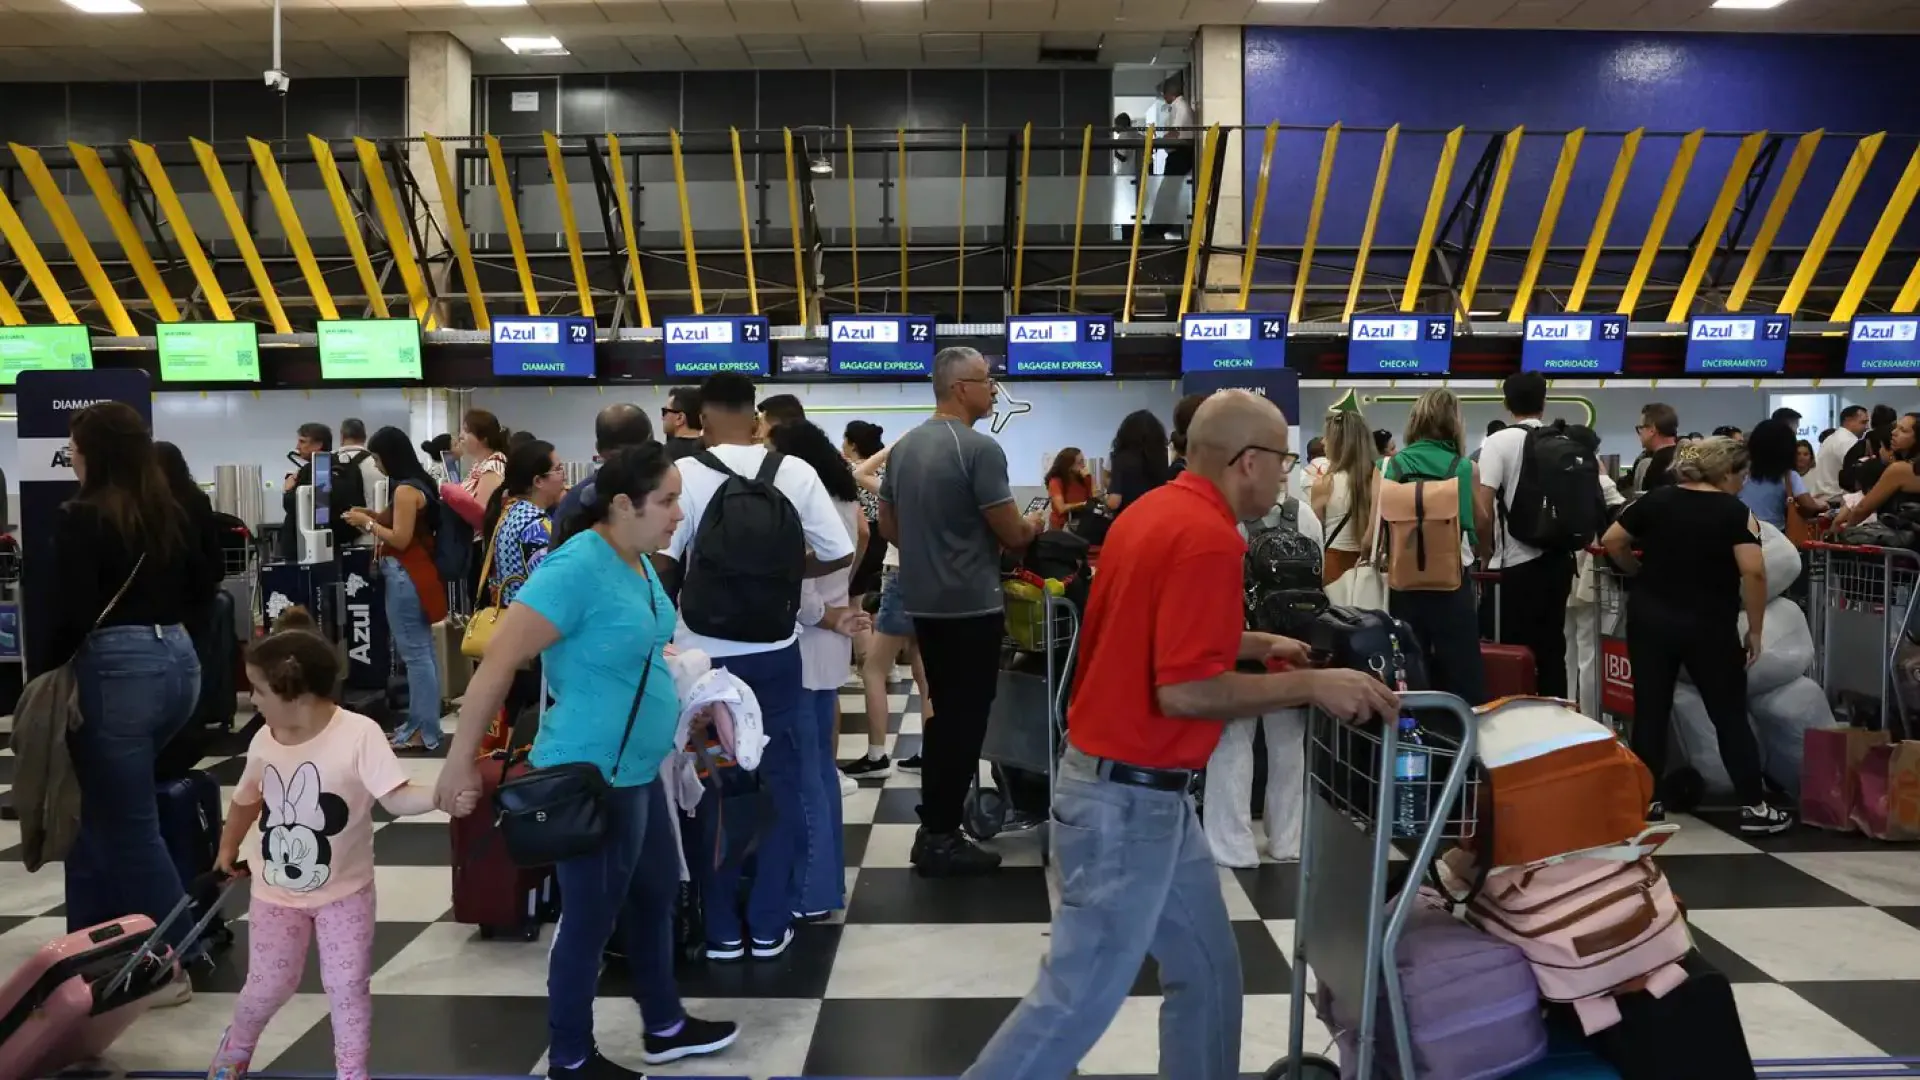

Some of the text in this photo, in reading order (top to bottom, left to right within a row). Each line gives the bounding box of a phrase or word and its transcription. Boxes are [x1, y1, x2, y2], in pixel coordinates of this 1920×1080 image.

[500, 326, 536, 340] Azul
[570, 325, 587, 337] 70
[672, 326, 709, 340] Azul
[744, 324, 760, 336] 71
[837, 325, 875, 340] Azul
[911, 324, 928, 336] 72
[1015, 325, 1053, 340] Azul
[1089, 323, 1106, 336] 73
[1190, 323, 1227, 337] Azul
[1263, 321, 1280, 333] 74
[1357, 324, 1395, 338] Azul
[1430, 323, 1446, 335] 75
[1531, 324, 1569, 338] Azul
[1603, 323, 1620, 335] 76
[1696, 324, 1733, 337] Azul
[1767, 322, 1783, 334] 77
[1857, 324, 1895, 339] Azul
[522, 362, 565, 372] DIAMANTE
[675, 361, 760, 372] BAGAGEM EXPRESSA
[839, 360, 925, 371] BAGAGEM EXPRESSA
[1017, 360, 1103, 371] BAGAGEM EXPRESSA
[1213, 358, 1254, 368] CHECK-IN
[1379, 359, 1419, 369] CHECK-IN
[1544, 359, 1599, 368] PRIORIDADES
[1702, 358, 1768, 368] ENCERRAMENTO
[52, 399, 112, 410] DIAMAN
[347, 604, 371, 665] Azul
